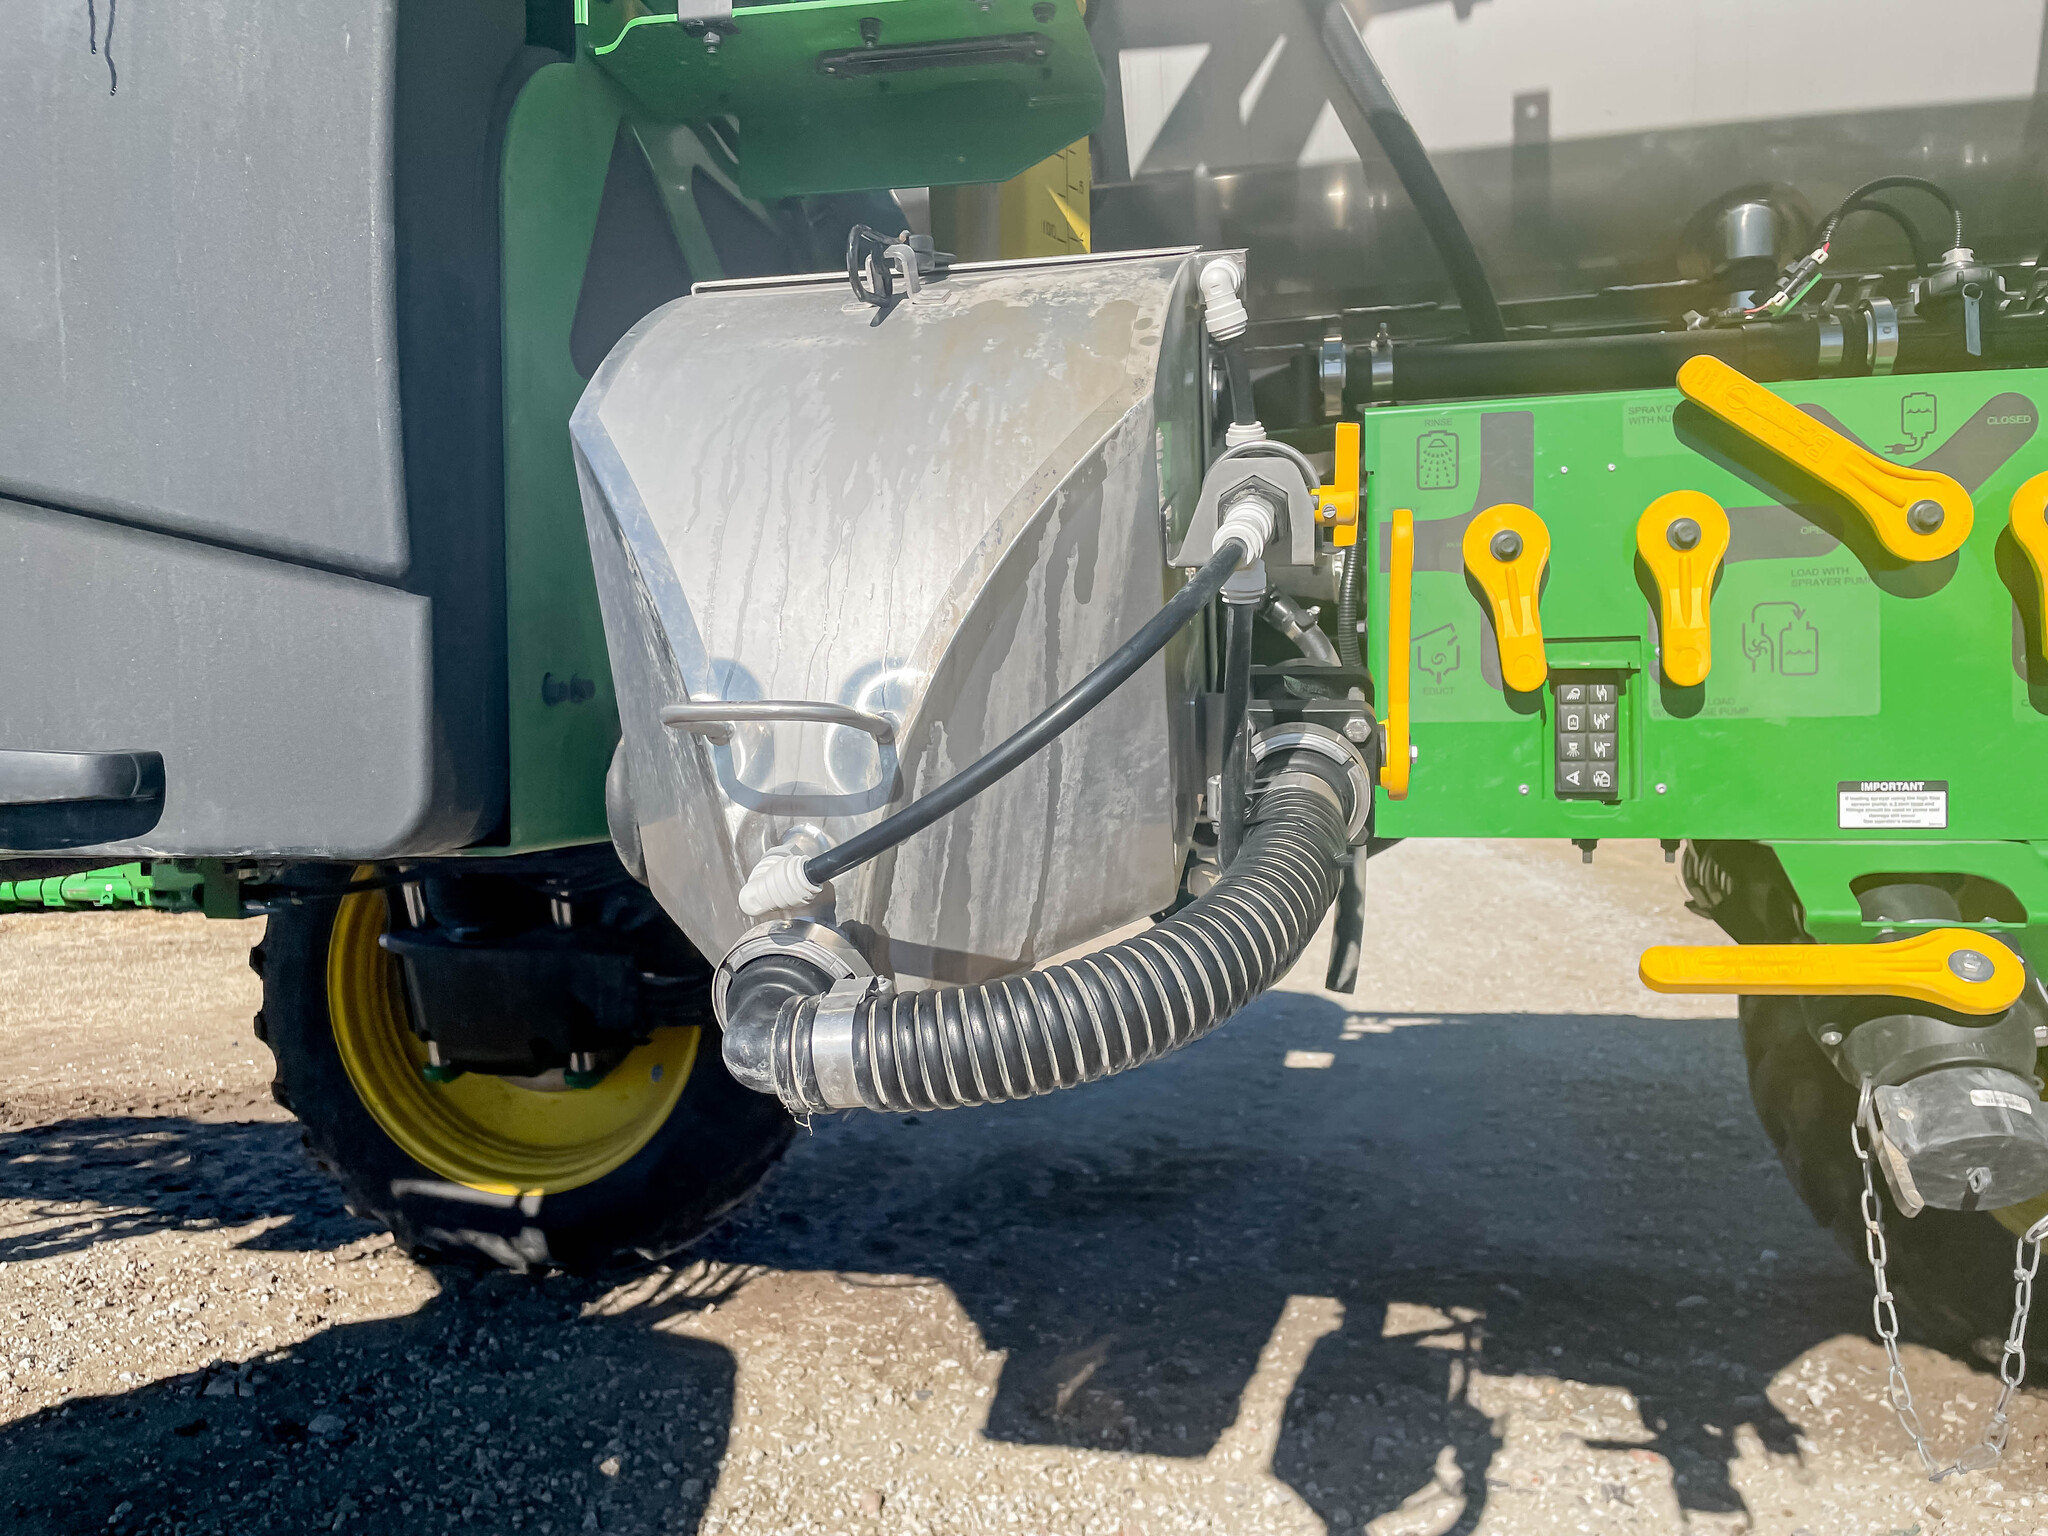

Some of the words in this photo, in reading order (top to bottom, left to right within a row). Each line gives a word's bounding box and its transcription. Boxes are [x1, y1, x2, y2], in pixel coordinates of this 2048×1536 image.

[1628, 405, 1662, 416] SPRAY
[1424, 417, 1453, 427] RINSE
[1628, 416, 1655, 425] WITH
[1986, 415, 2032, 425] CLOSED
[1800, 525, 1827, 535] OPE
[1791, 568, 1819, 578] LOAD
[1822, 566, 1849, 576] WITH
[1791, 577, 1842, 588] SPRAYER
[1860, 781, 1925, 792] IMPORTANT
